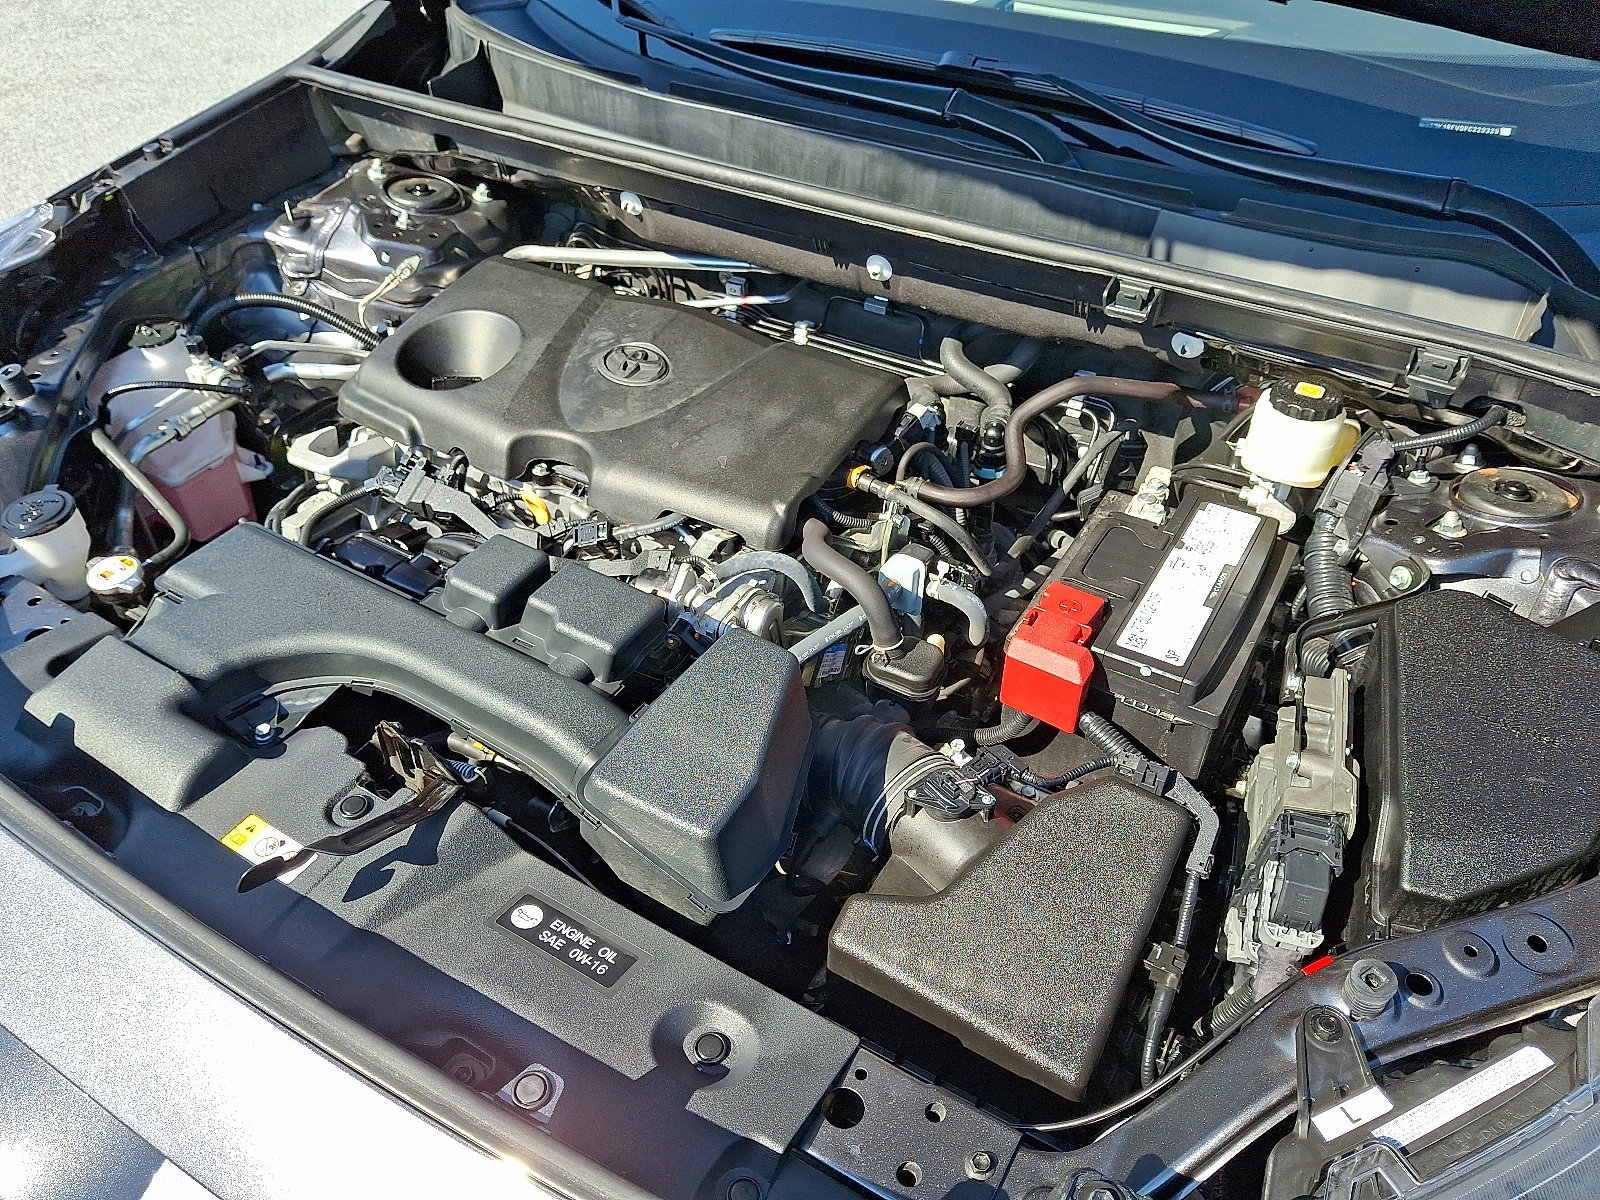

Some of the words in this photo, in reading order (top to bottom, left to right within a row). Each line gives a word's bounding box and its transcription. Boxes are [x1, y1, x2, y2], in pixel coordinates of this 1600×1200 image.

[538, 930, 567, 951] SAE
[568, 948, 609, 976] 0W-16
[549, 919, 597, 950] ENGINE
[597, 946, 619, 965] OIL
[1340, 1106, 1362, 1124] L
